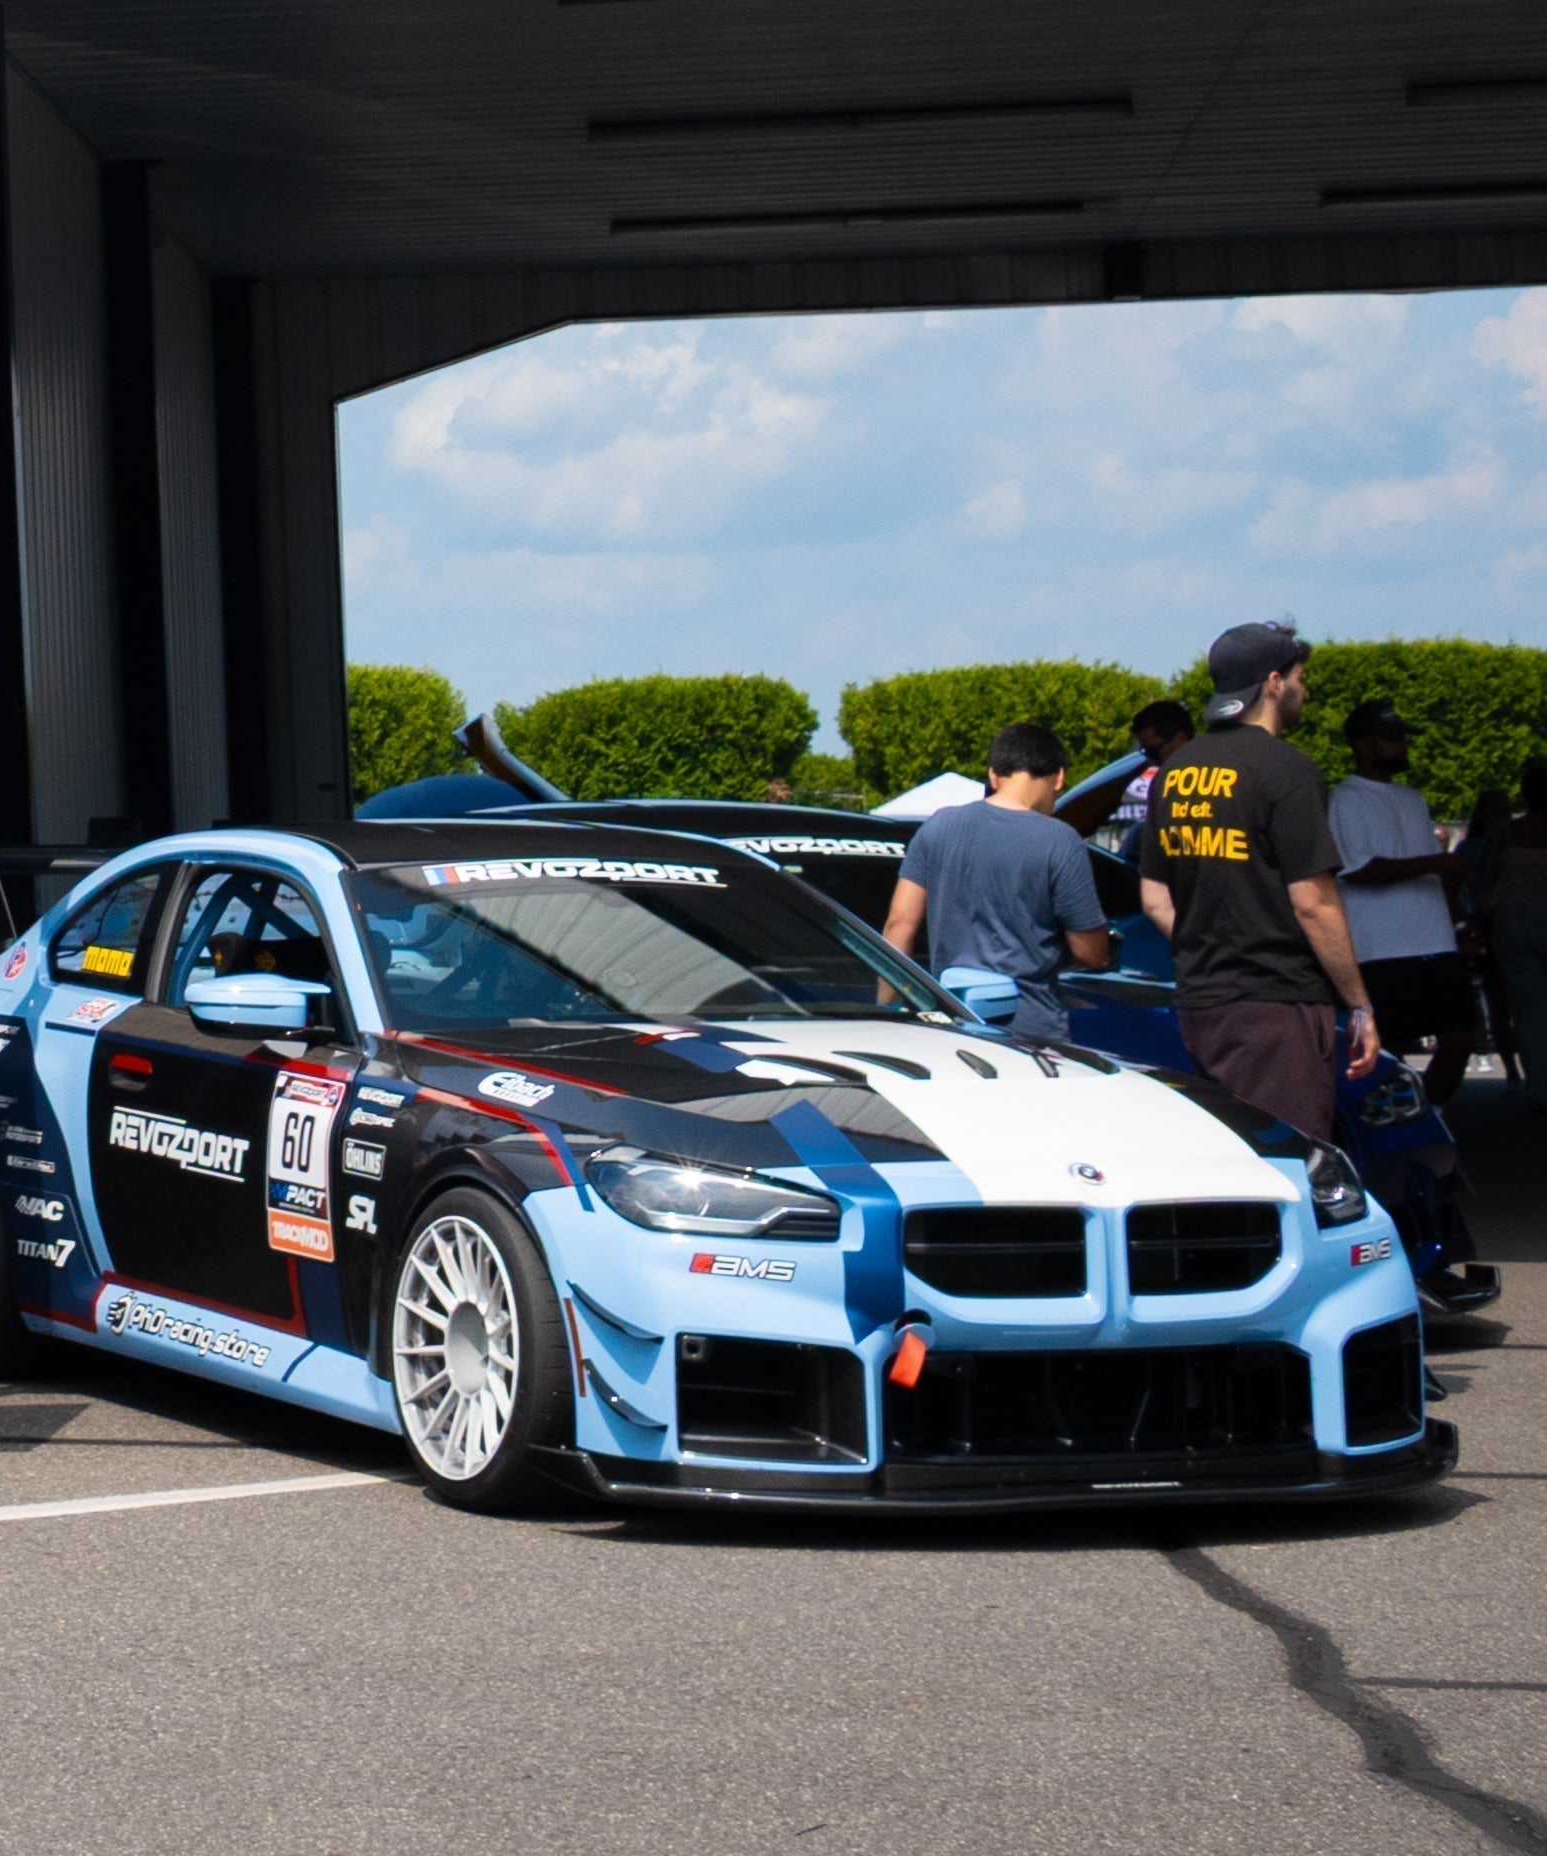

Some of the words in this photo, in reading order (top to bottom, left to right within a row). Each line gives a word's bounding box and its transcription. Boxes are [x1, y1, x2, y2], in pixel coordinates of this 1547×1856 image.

[1162, 765, 1238, 798] POUR
[457, 858, 720, 885] REVOZPORT
[109, 1110, 251, 1176] REVOZPORT
[282, 1111, 315, 1173] 60
